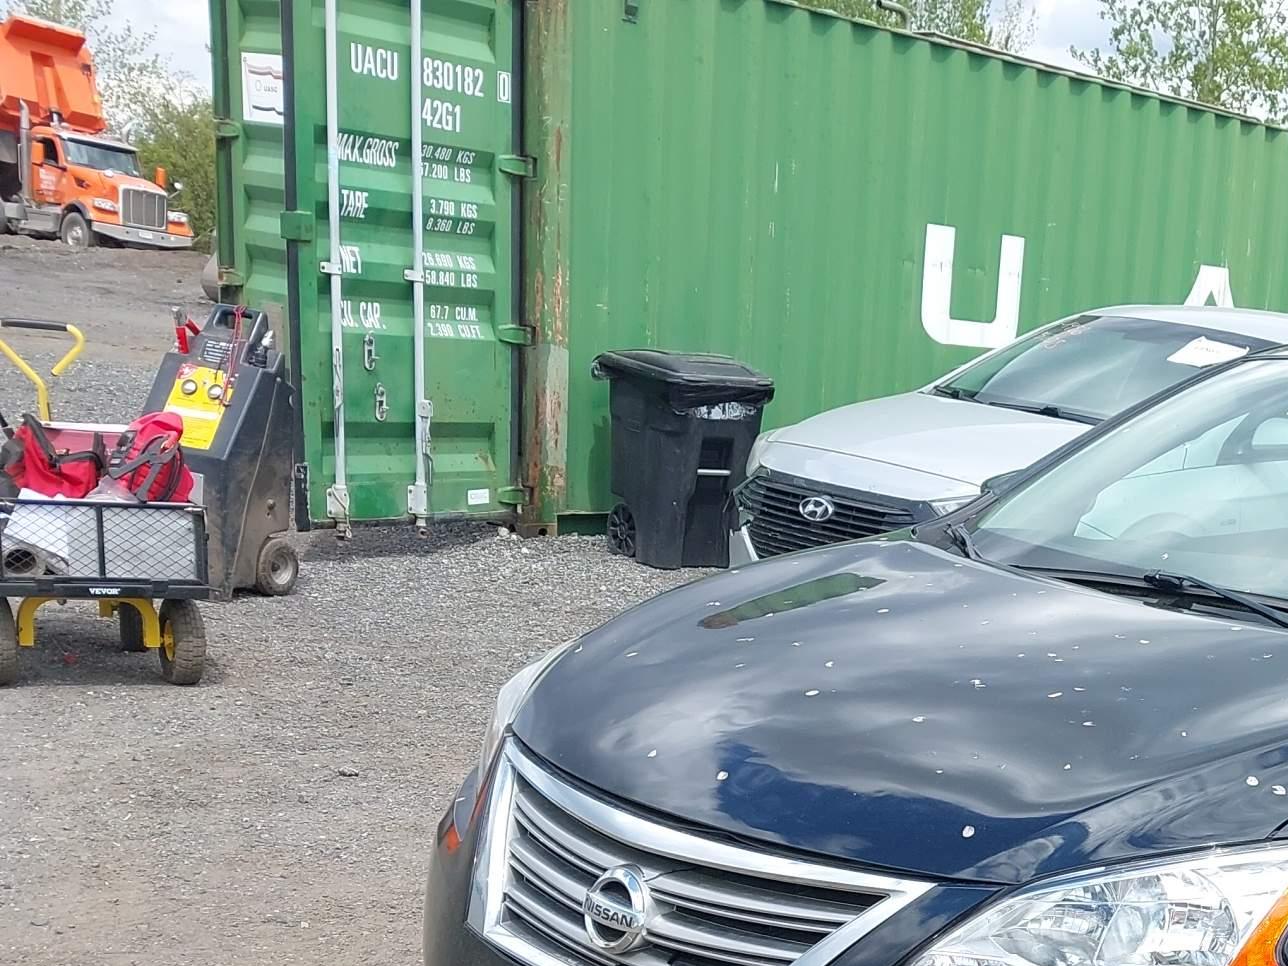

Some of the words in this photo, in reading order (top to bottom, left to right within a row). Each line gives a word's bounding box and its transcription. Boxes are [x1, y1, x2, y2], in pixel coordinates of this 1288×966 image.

[350, 42, 399, 81] UACU
[423, 57, 485, 97] 830182
[422, 98, 462, 133] 42G1
[336, 132, 399, 168] MAX.GROSS
[456, 150, 475, 165] KGS
[454, 167, 471, 183] LBS
[341, 189, 369, 218] TARE
[430, 199, 455, 216] 3.790
[461, 203, 478, 219] KGS
[426, 217, 452, 232] 8.360
[456, 221, 476, 235] LBS
[339, 245, 362, 274] NET
[456, 255, 476, 271] KGS
[425, 270, 455, 287] 58.840
[461, 273, 478, 288] LBS
[360, 301, 387, 330] CAP.
[430, 305, 449, 320] 67.7
[427, 323, 454, 337] 2.390
[88, 587, 119, 595] VEVOR
[584, 894, 633, 929] NISSAN
